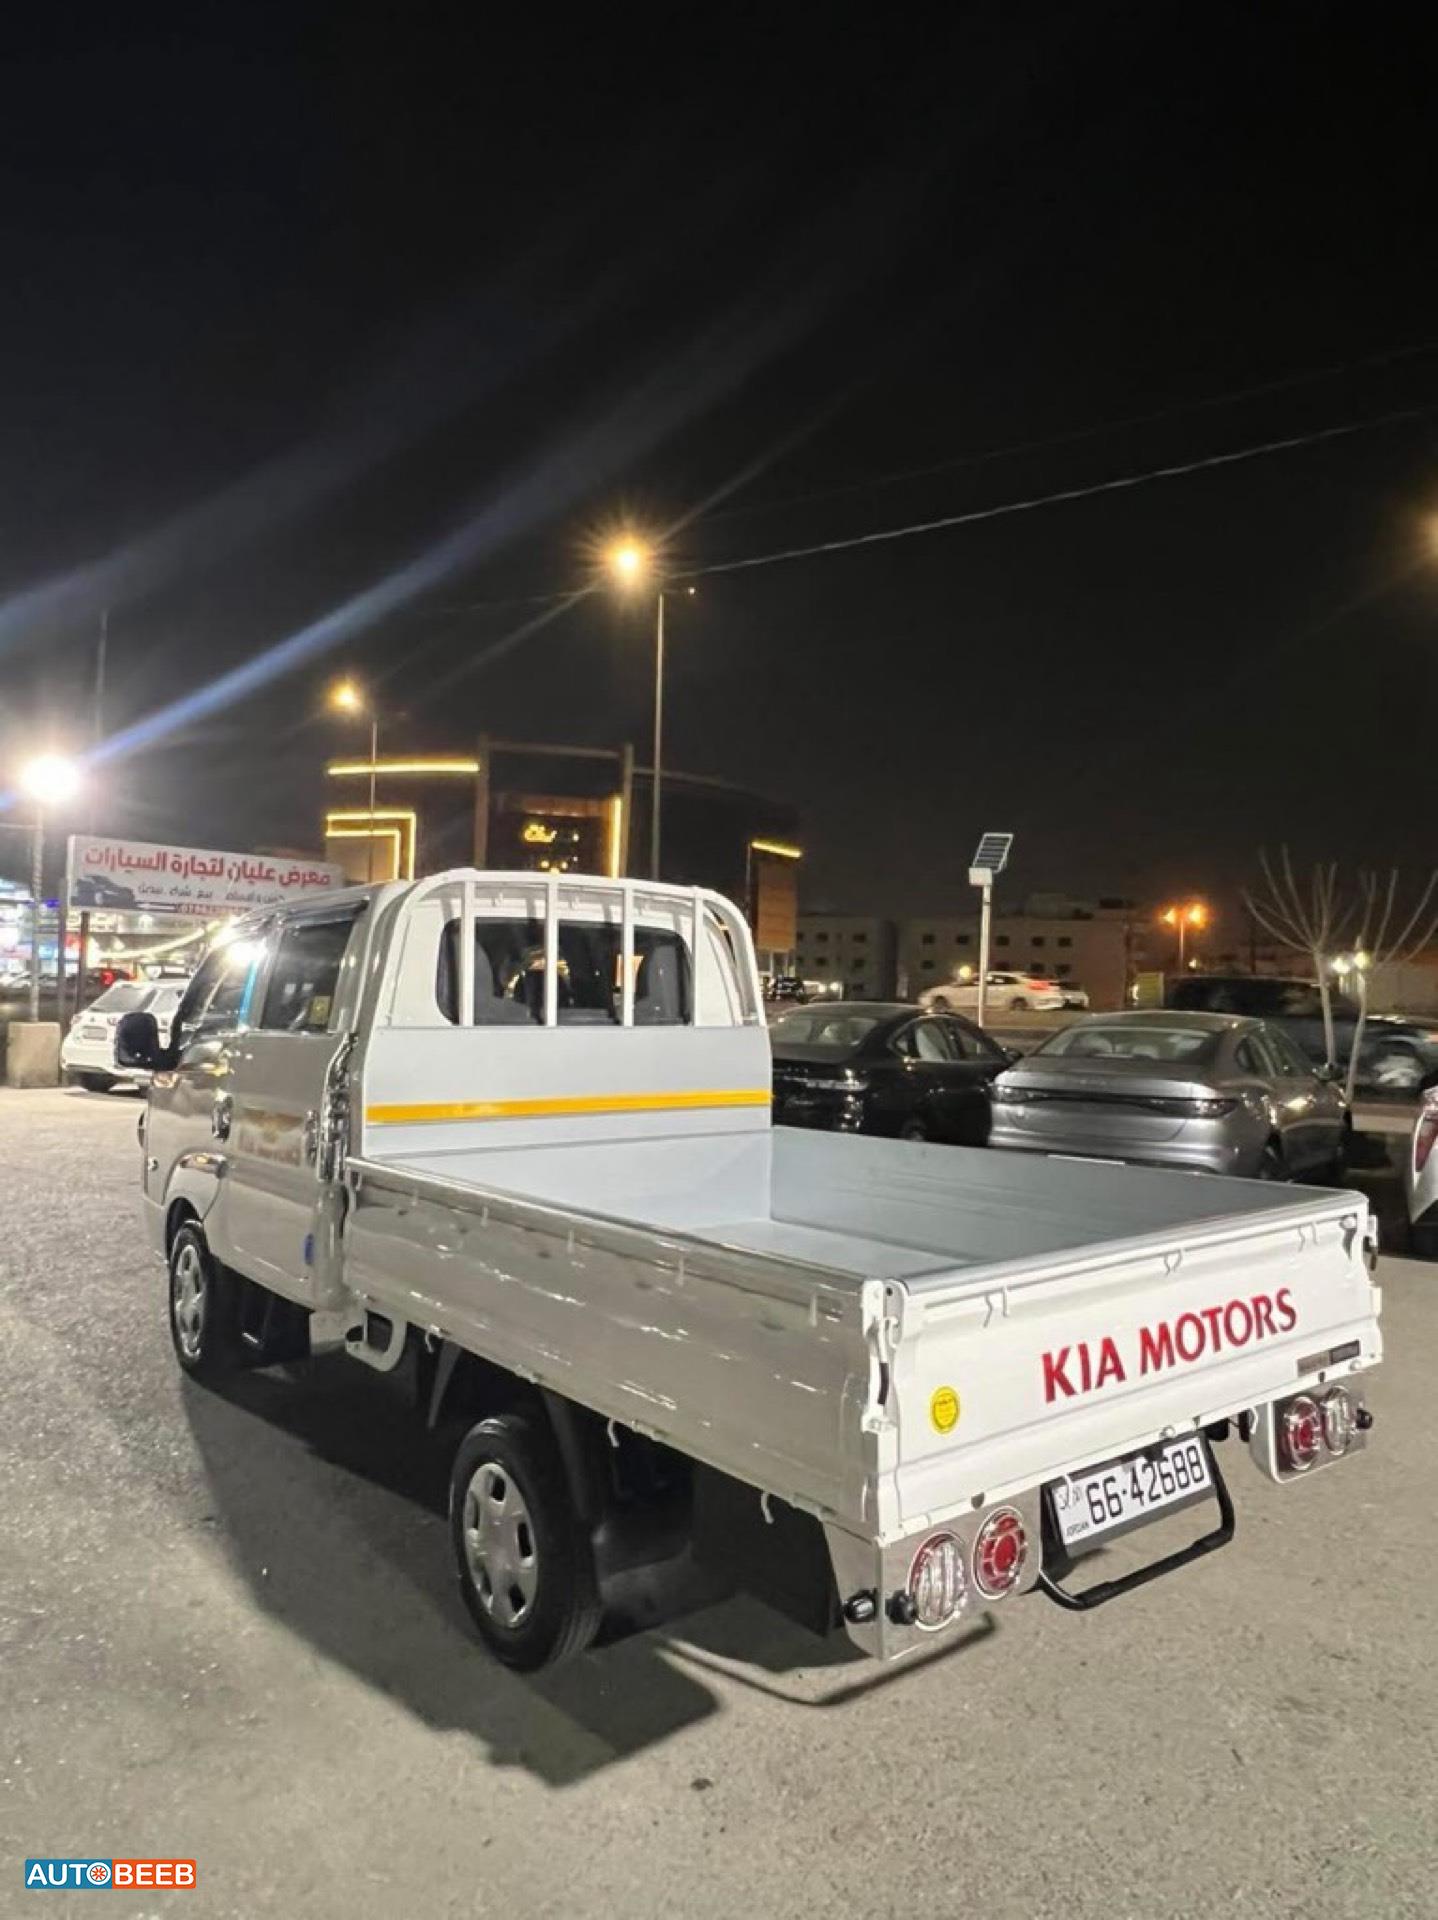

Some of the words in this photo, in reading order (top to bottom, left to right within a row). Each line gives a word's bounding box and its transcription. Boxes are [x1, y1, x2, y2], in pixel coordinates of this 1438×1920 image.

[85, 846, 168, 873] السيارات
[171, 854, 224, 880] لتجارة
[278, 866, 331, 889] معرض
[1041, 1336, 1127, 1404] KIA
[1139, 1287, 1298, 1377] MOTORS
